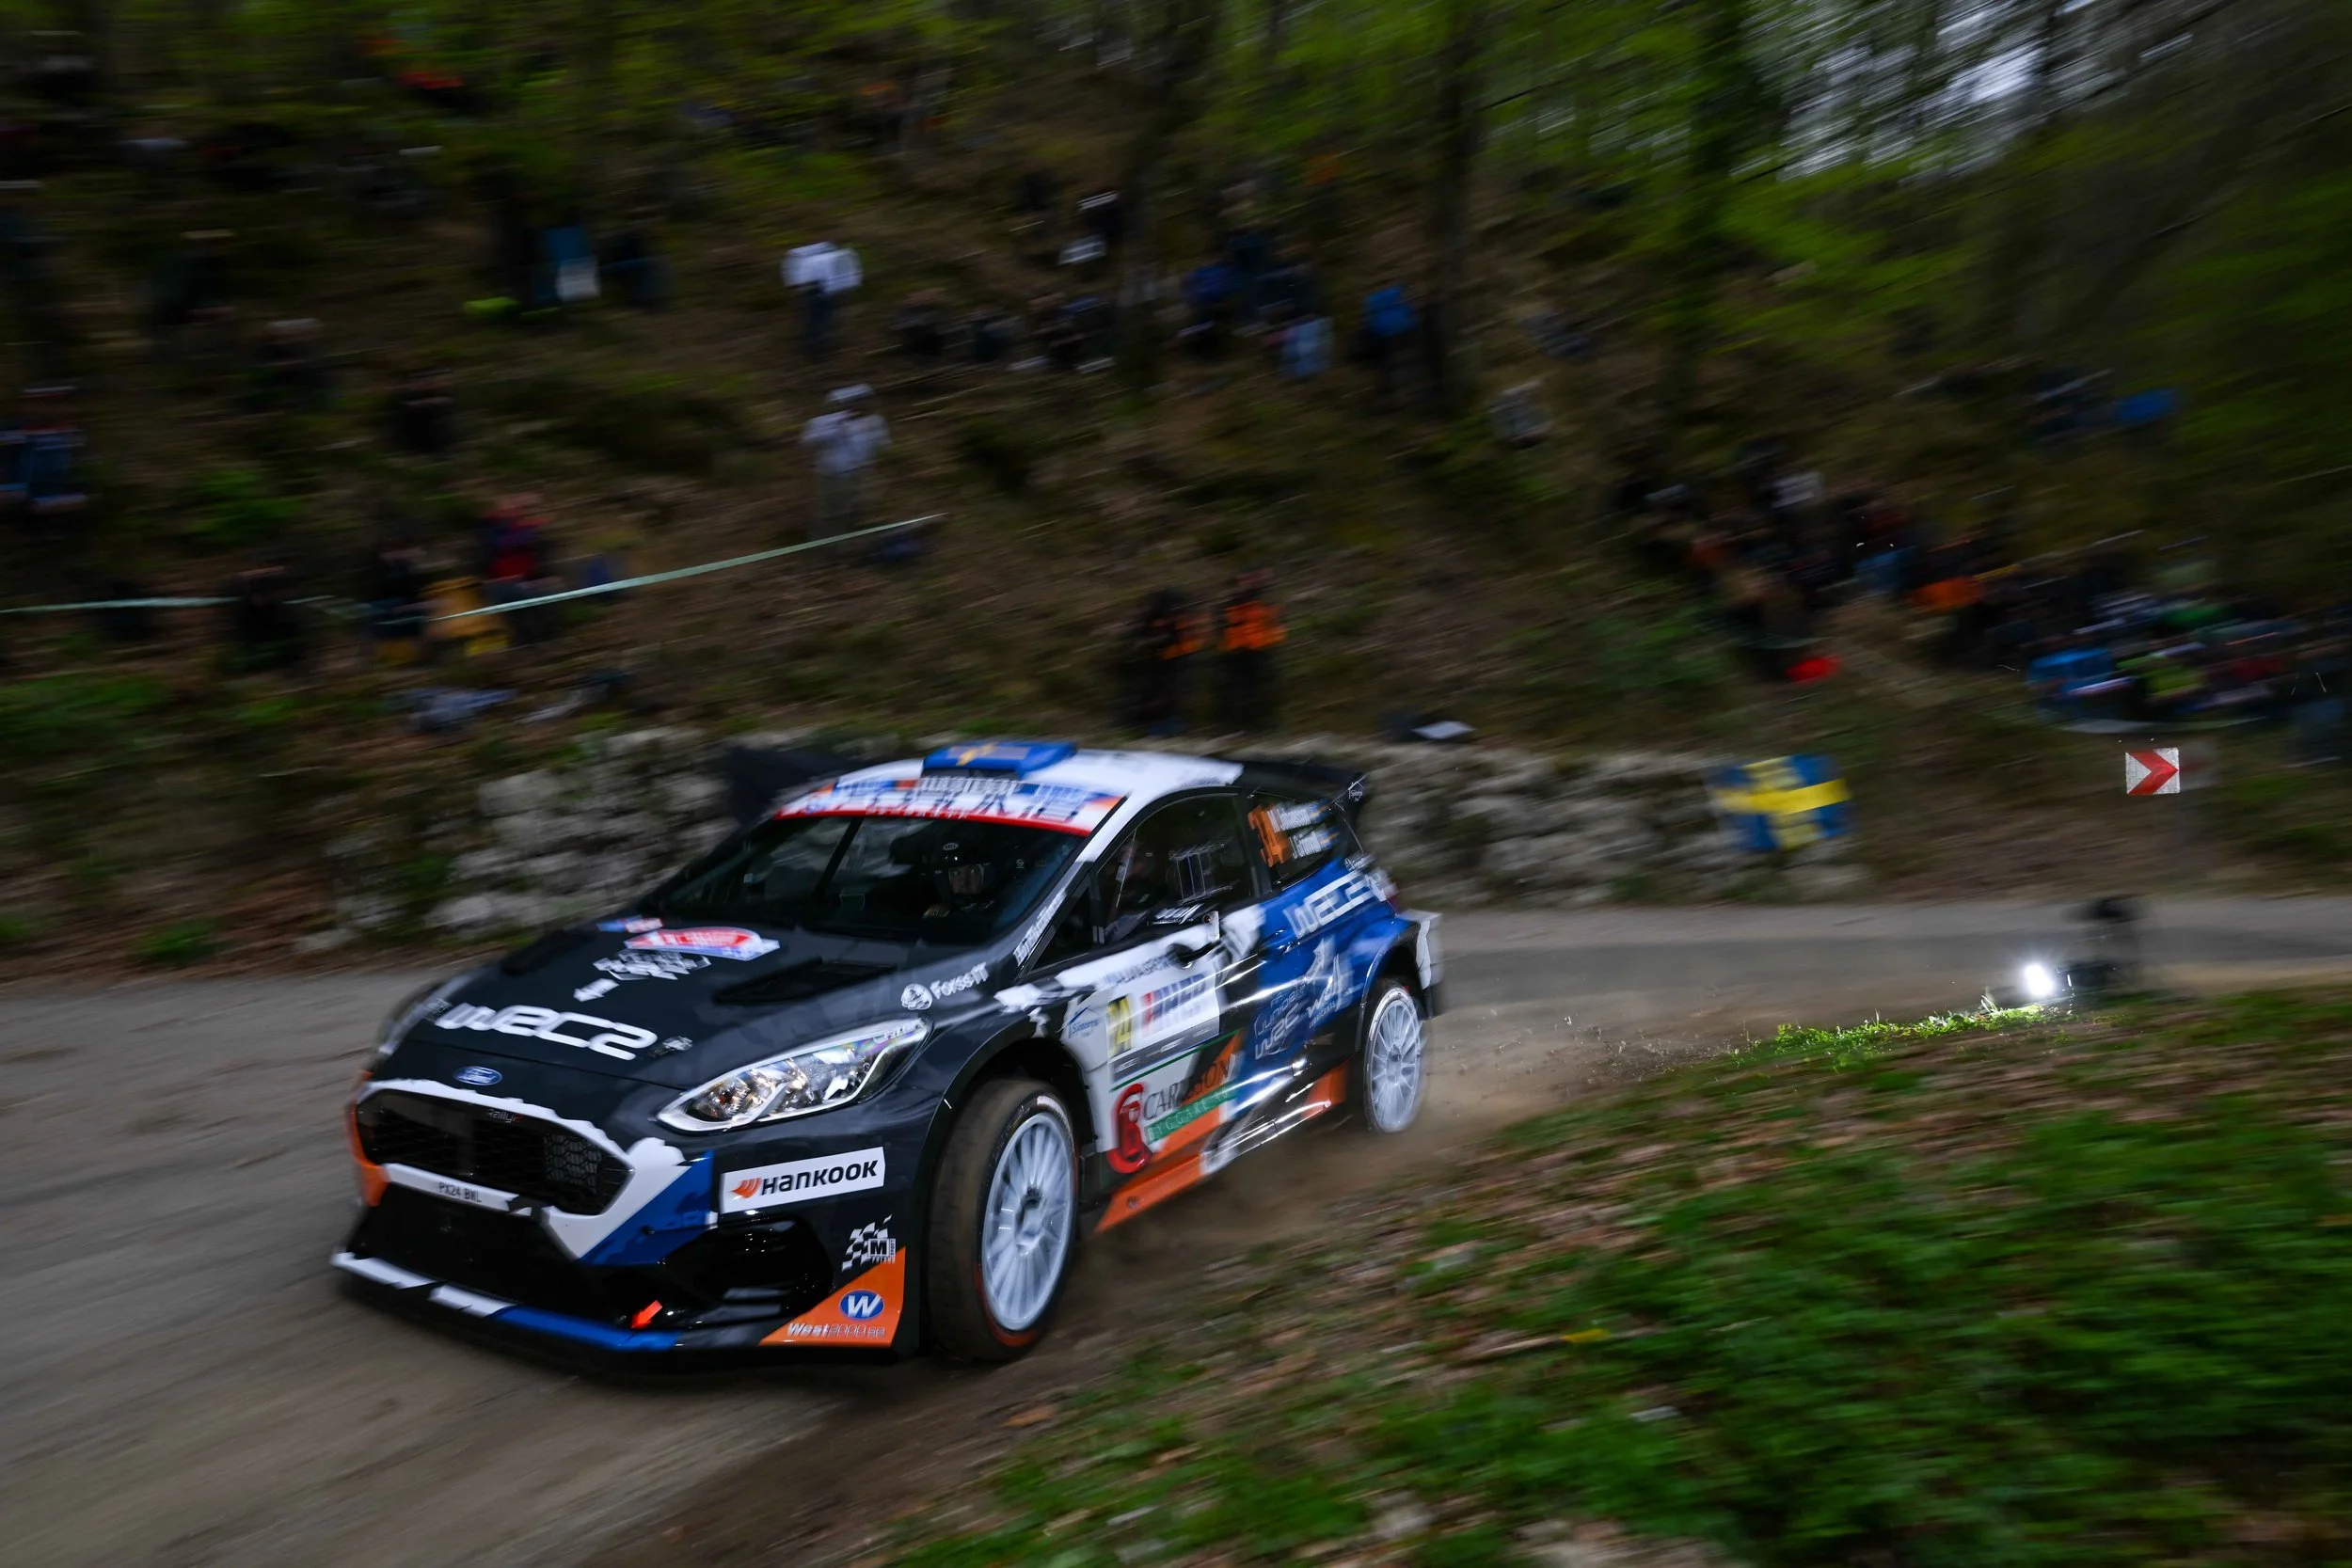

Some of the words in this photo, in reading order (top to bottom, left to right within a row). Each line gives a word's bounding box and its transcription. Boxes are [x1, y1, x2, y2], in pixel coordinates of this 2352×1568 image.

[761, 1160, 879, 1196] HANKOOK
[870, 1240, 887, 1255] M
[848, 1294, 882, 1317] W
